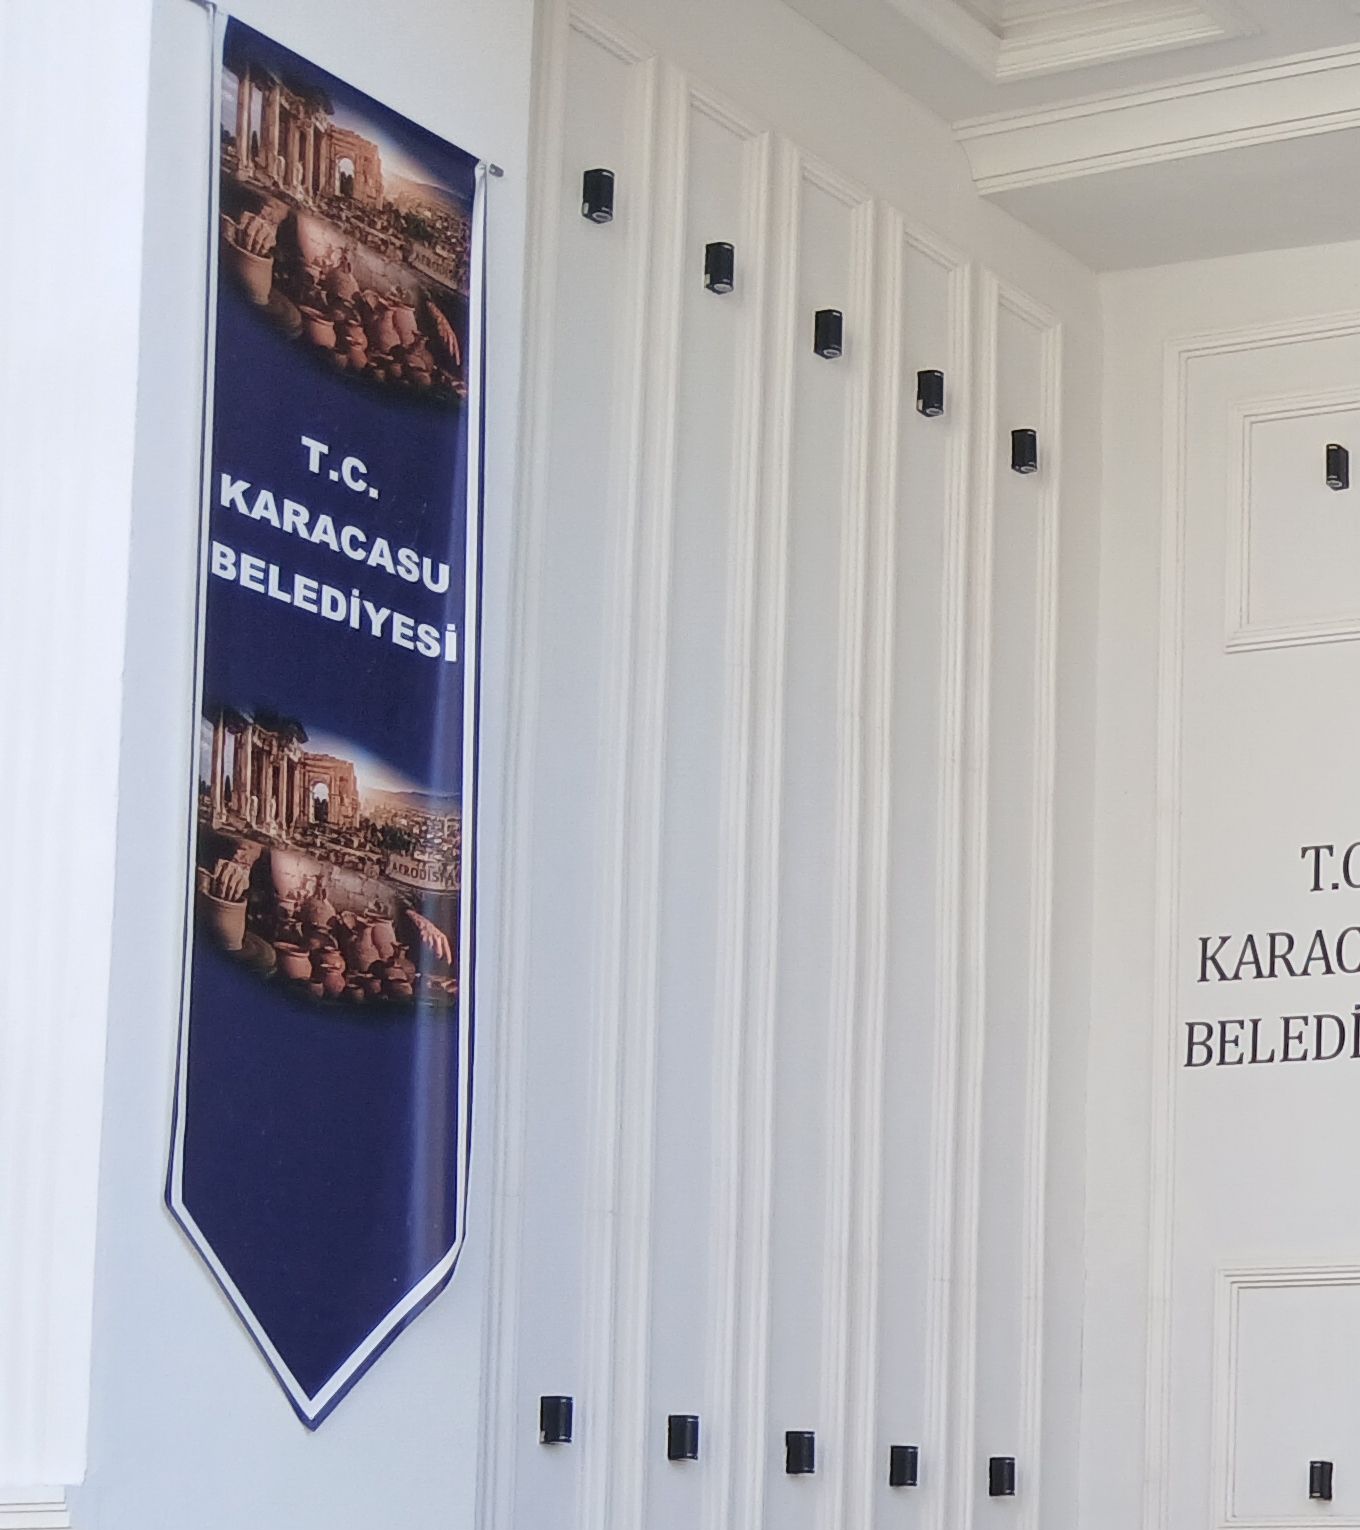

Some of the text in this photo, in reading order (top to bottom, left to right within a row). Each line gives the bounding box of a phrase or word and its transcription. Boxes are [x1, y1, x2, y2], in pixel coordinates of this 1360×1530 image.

[300, 435, 380, 500] T.C.
[219, 472, 450, 594] KARACASU
[210, 540, 457, 662] BELEDİYESİ
